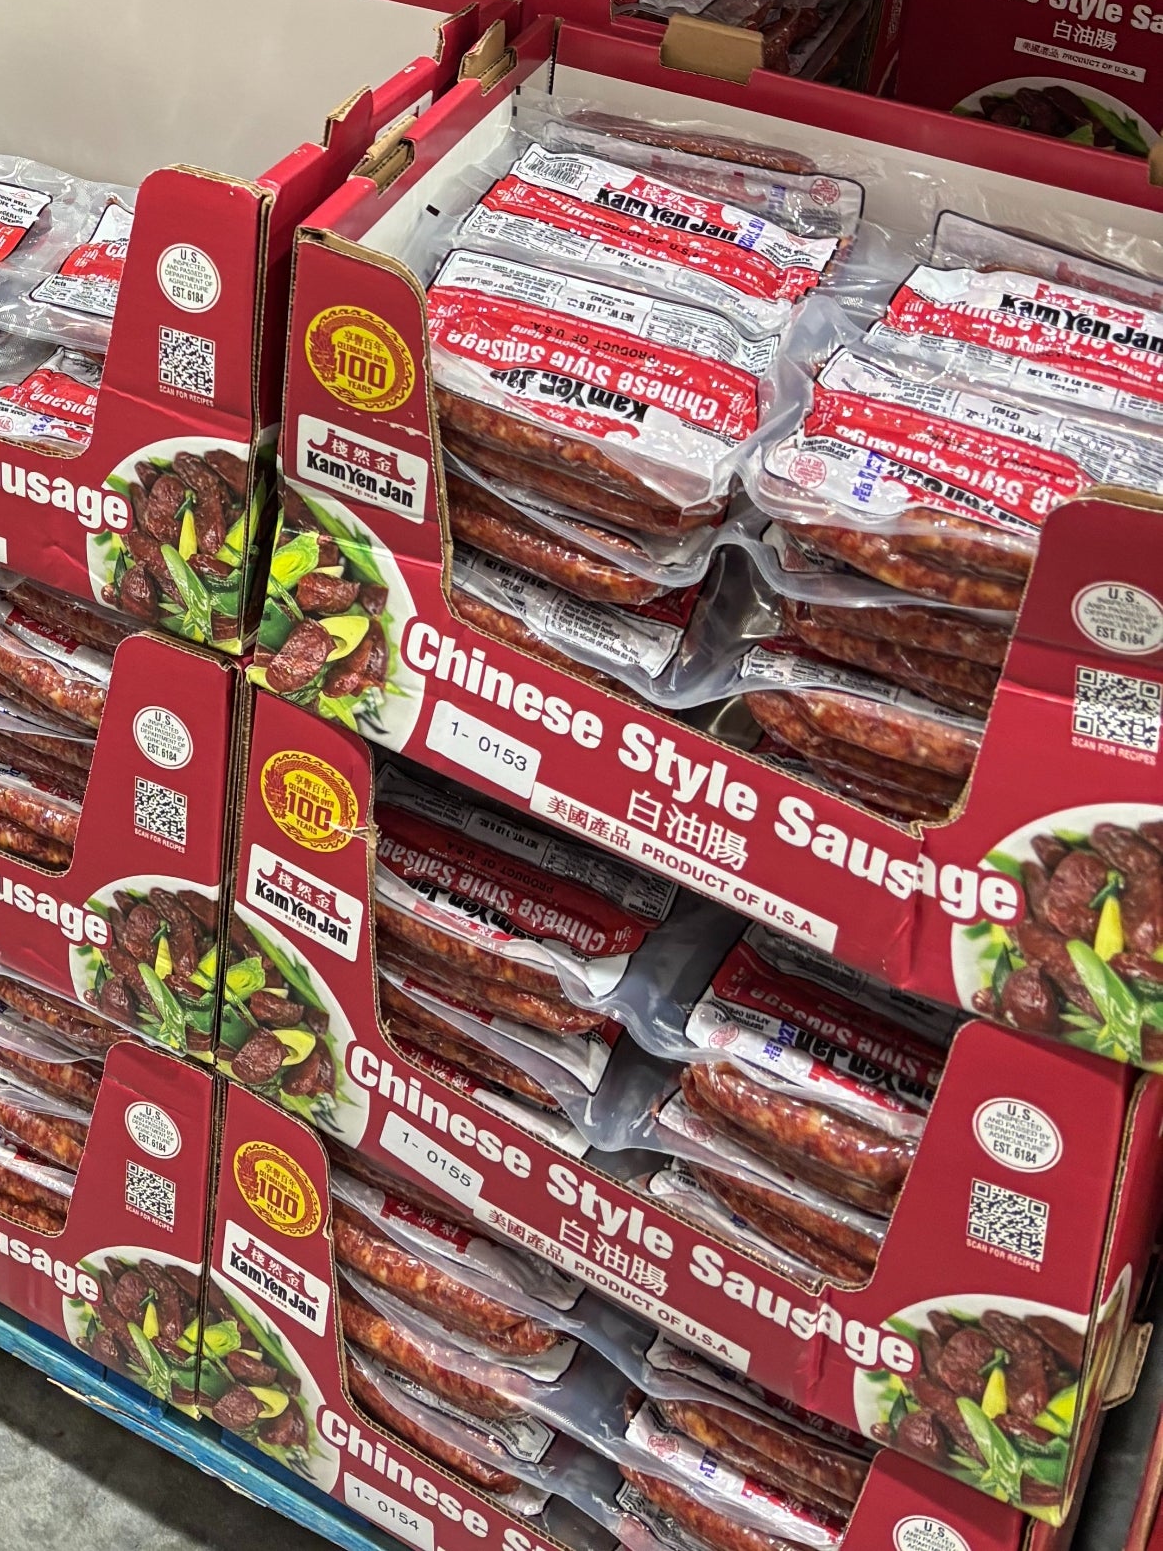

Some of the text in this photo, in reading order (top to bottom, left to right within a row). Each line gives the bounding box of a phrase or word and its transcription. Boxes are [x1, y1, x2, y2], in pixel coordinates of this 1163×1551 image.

[1052, 19, 1118, 52] 白油腸
[336, 352, 388, 391] 100
[347, 379, 374, 396] YEARS
[306, 450, 414, 510] Kam Yen Jan
[407, 621, 604, 750] Chinese
[617, 728, 760, 825] Style
[773, 793, 1020, 921] Sausage
[450, 719, 529, 773] 1- 0153
[546, 795, 632, 852] 美國產品
[626, 788, 750, 873] 白油腸
[254, 877, 349, 946] Kam Yen Jan
[641, 841, 820, 940] PRODUCT OF U.S.A.
[401, 1129, 473, 1189] 1- 0155
[993, 1139, 1038, 1165] EST. 6184
[349, 1044, 916, 1374] Chinese Style Sausage
[228, 1249, 318, 1323] Kam Yen Jan
[965, 1238, 1042, 1274] SCAN FOR RECIPES
[321, 1408, 490, 1539] Chinese
[353, 1485, 421, 1532] 1- 0154
